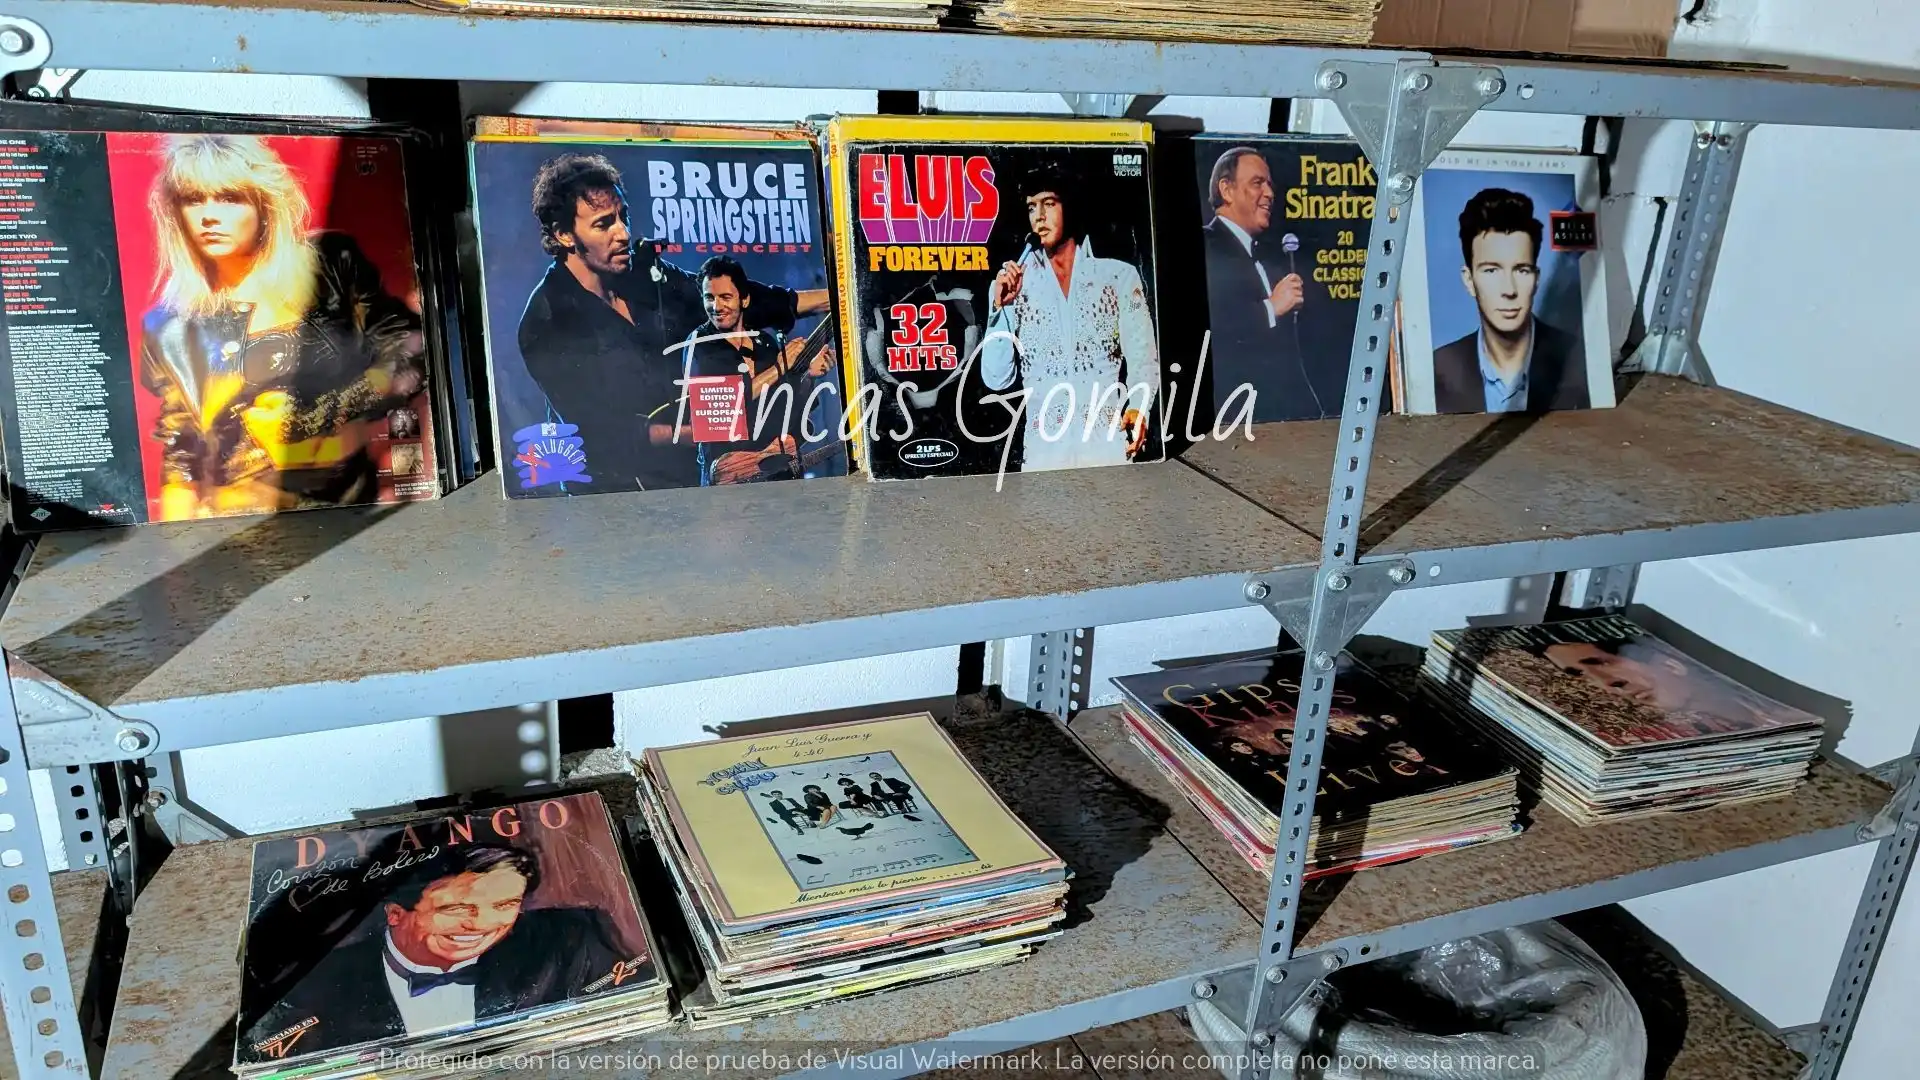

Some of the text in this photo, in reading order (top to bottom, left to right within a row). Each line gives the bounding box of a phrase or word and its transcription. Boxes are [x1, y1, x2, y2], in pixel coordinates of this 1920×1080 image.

[1113, 154, 1142, 165] RCA
[1300, 155, 1377, 186] Frank
[648, 160, 807, 200] BRUCE
[859, 154, 999, 243] ELVIS
[1285, 187, 1377, 219] Sinatra
[652, 198, 812, 243] SPRINGSTEEN
[653, 244, 812, 253] IN CONCERT
[1337, 231, 1354, 246] 20
[869, 246, 990, 271] FOREVER
[891, 302, 949, 346] 32
[887, 345, 958, 372] HITS
[916, 445, 923, 453] 2
[1163, 678, 1300, 709] Gips
[742, 743, 780, 757] Juan
[785, 737, 813, 750] Luis
[815, 733, 861, 746] Guerra
[295, 800, 569, 869] DYANGO
[322, 845, 440, 895] de Bolero
[612, 961, 638, 986] 2
[253, 1024, 301, 1051] ANUNCIADO
[261, 1029, 307, 1057] TV
